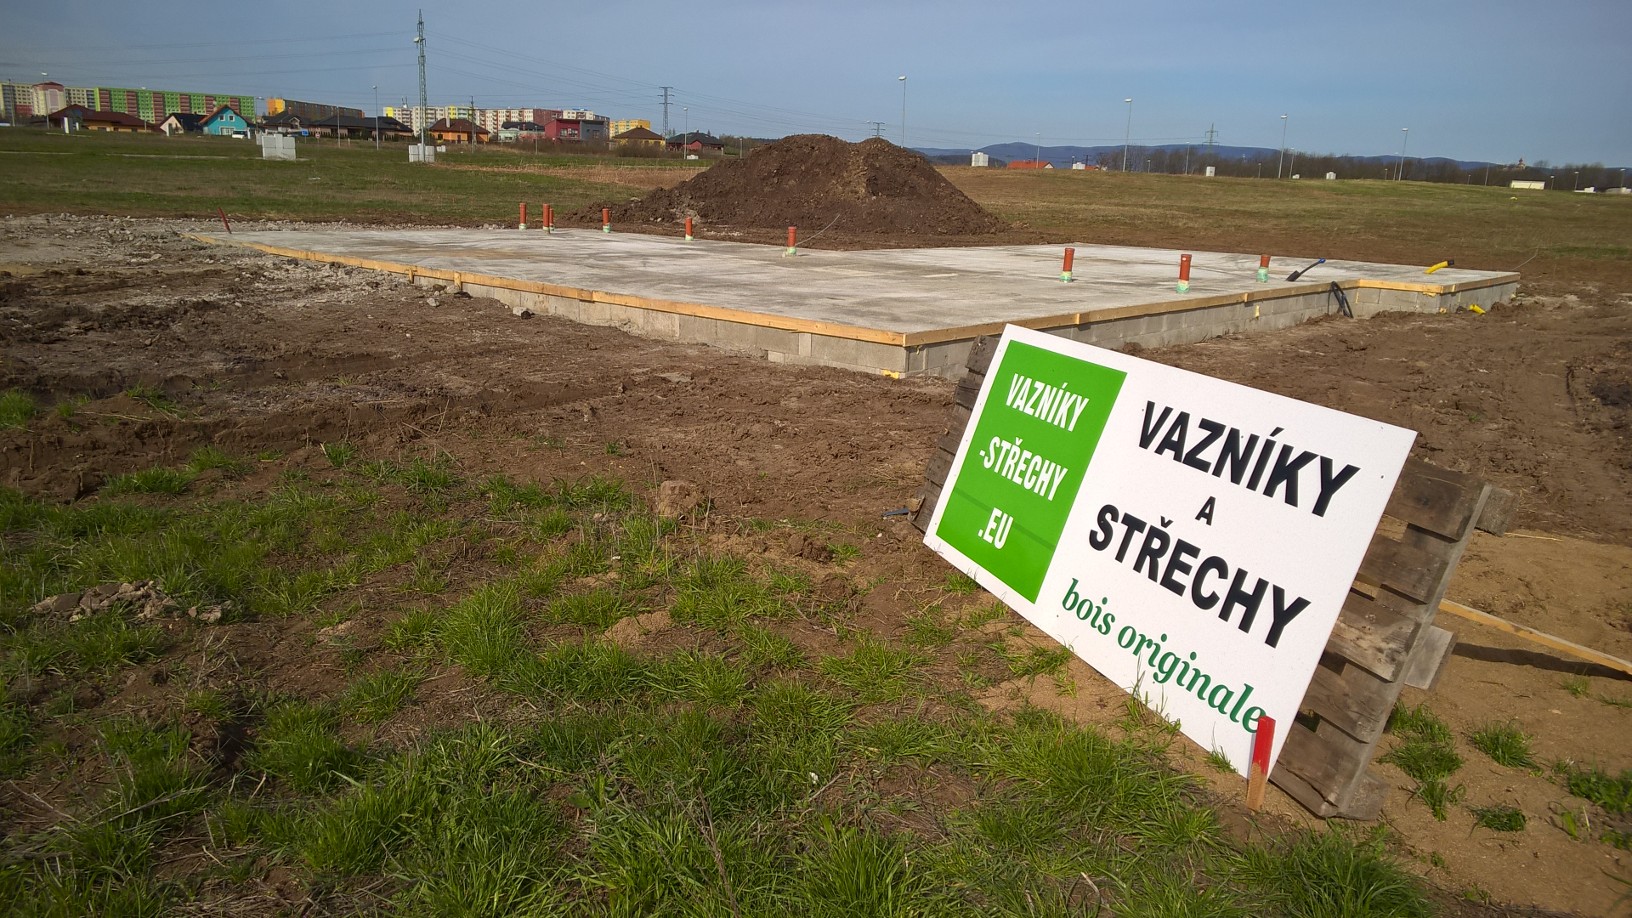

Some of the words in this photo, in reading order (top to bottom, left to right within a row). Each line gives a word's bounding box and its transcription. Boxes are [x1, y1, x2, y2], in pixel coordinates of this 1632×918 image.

[1005, 373, 1089, 432] VAZNÍKY
[979, 437, 1068, 501] -STŘECHY
[1138, 400, 1361, 518] VAZNÍKY
[978, 507, 1014, 549] .EU
[1195, 496, 1216, 526] A
[1089, 504, 1311, 649] STŘECHY
[1062, 578, 1116, 636] bois
[1118, 625, 1268, 735] originale
